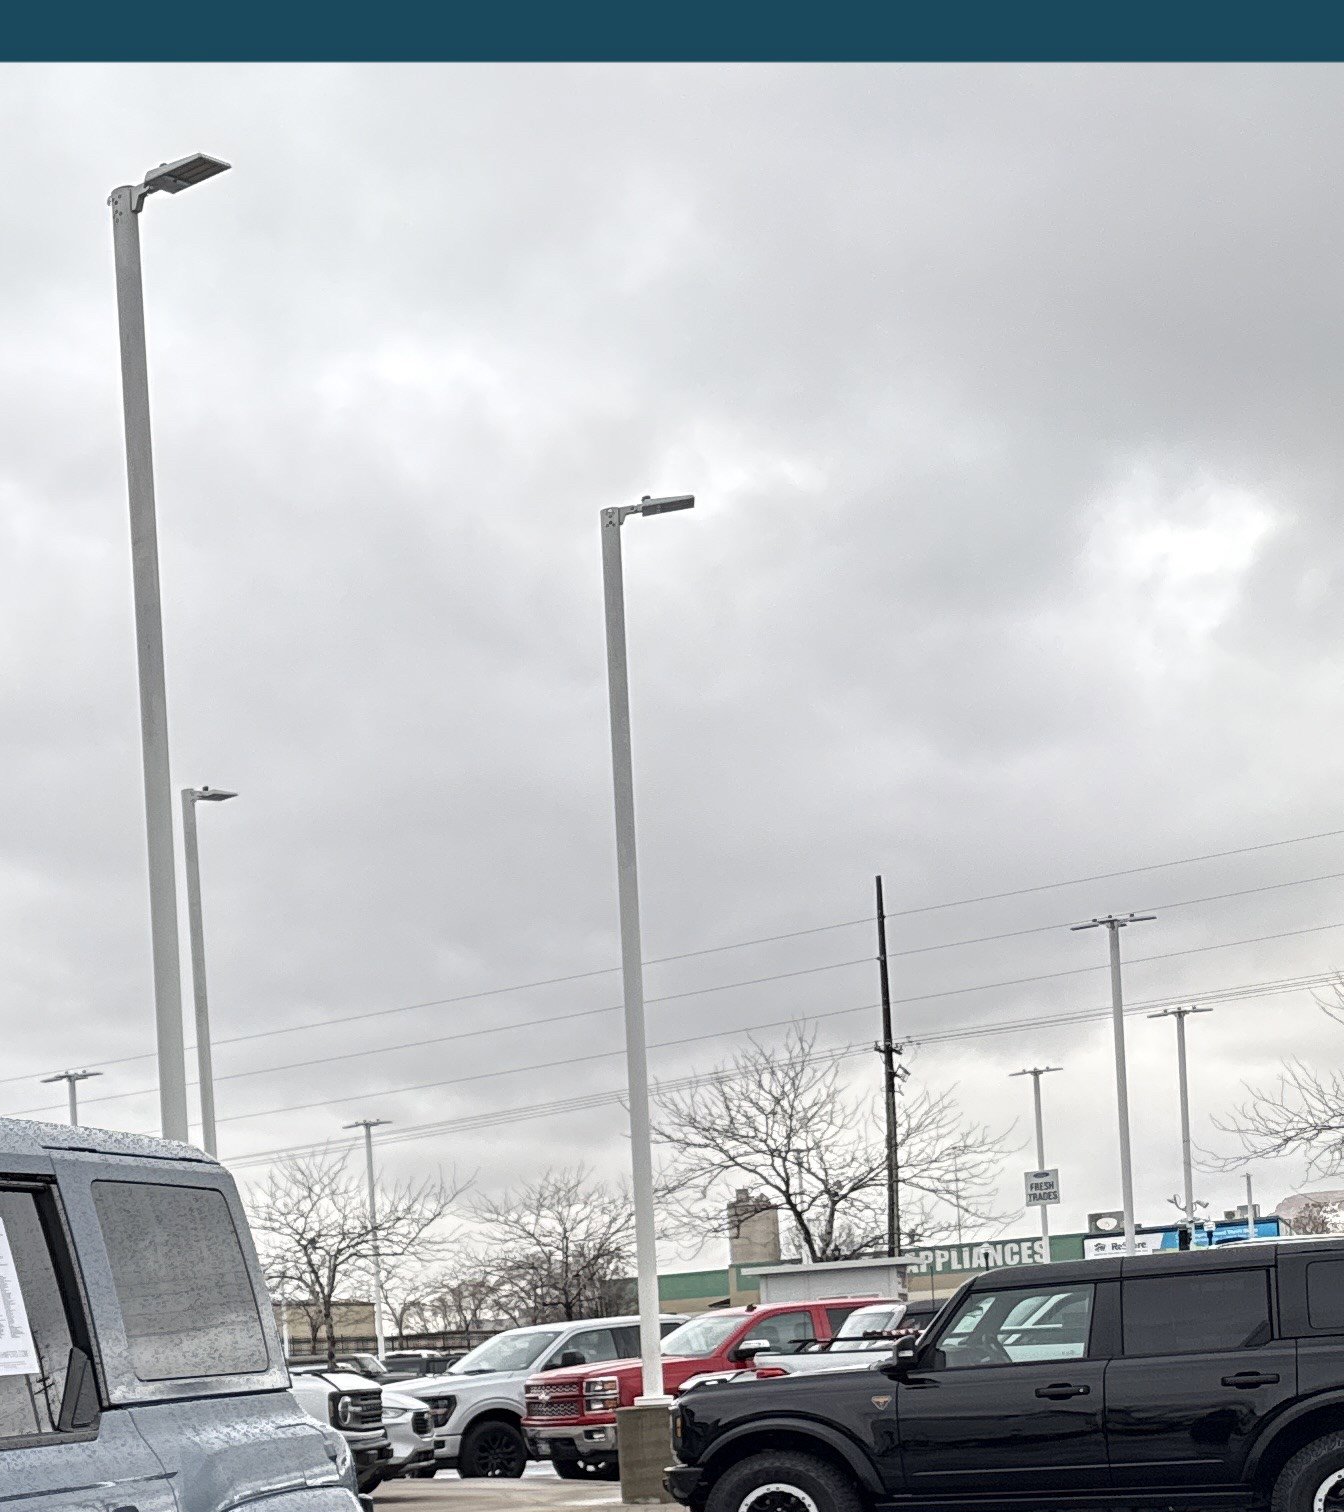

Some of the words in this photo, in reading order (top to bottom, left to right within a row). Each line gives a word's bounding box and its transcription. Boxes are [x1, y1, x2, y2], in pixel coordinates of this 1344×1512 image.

[1029, 1181, 1054, 1191] FRESH
[1027, 1191, 1059, 1202] TRADES
[906, 1240, 1044, 1274] APPLIANCES
